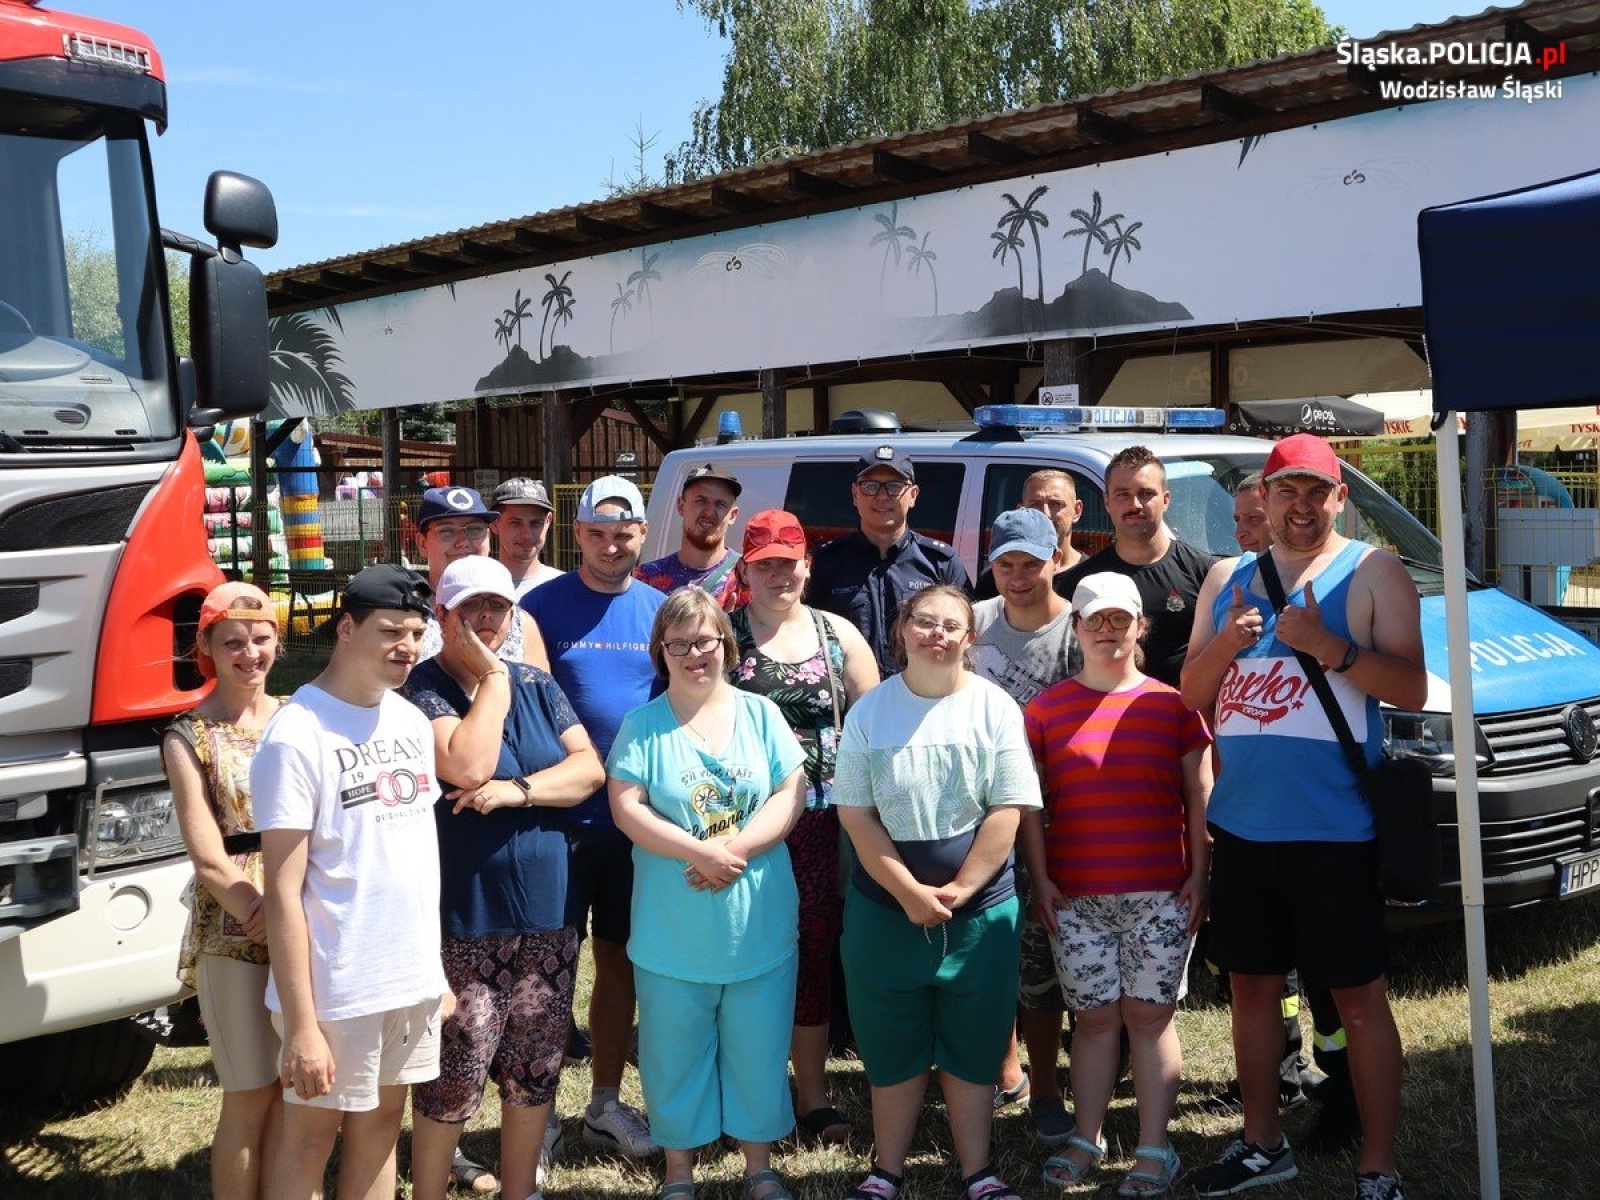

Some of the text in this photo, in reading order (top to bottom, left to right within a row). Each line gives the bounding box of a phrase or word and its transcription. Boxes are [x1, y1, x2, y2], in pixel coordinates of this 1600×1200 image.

[1094, 409, 1134, 424] OLICJA
[1384, 420, 1414, 434] YSKIE
[556, 640, 593, 650] TOMMY
[351, 771, 365, 785] 19
